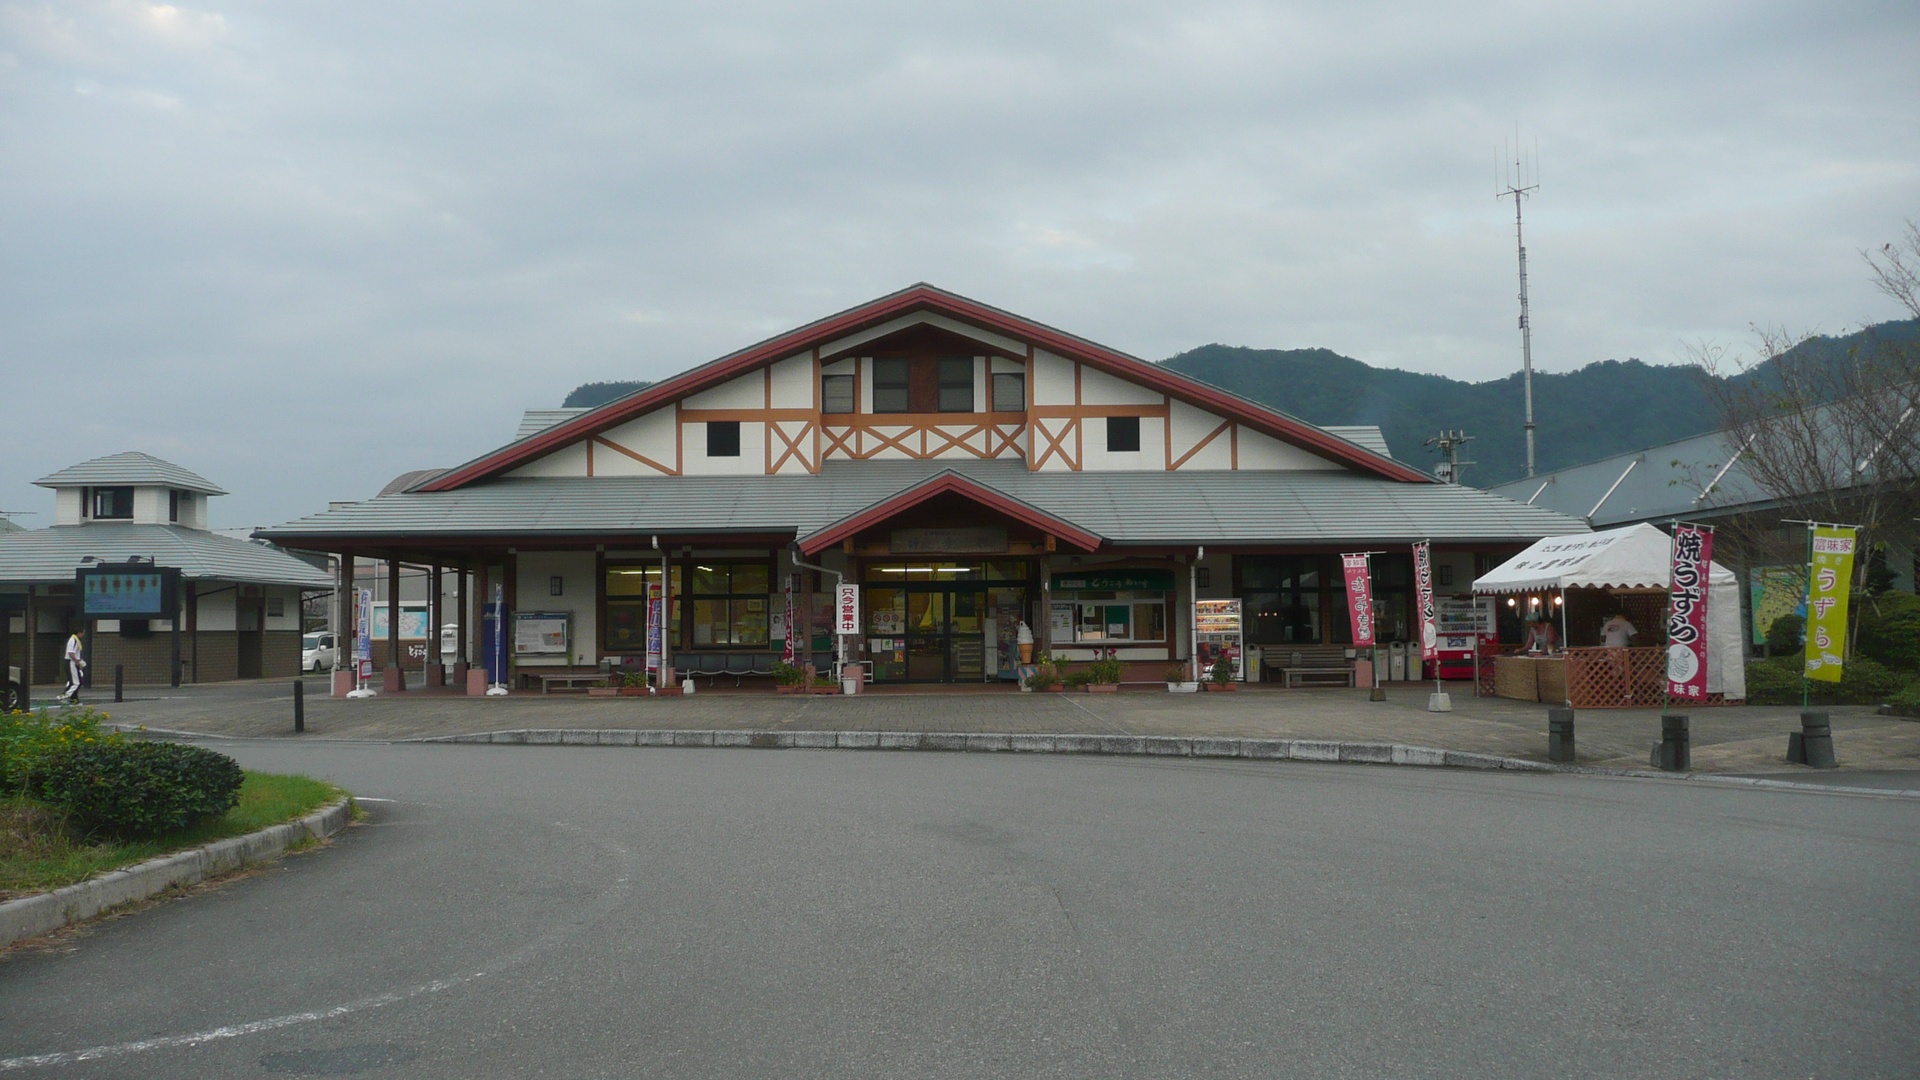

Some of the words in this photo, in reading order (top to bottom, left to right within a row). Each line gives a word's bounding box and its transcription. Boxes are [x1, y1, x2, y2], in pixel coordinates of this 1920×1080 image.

[1814, 538, 1853, 552] 富味家
[842, 588, 854, 631] 只今営業中
[1669, 532, 1703, 645] 焼うずら
[1813, 567, 1836, 649] うずら
[1666, 681, 1700, 698] 味家
